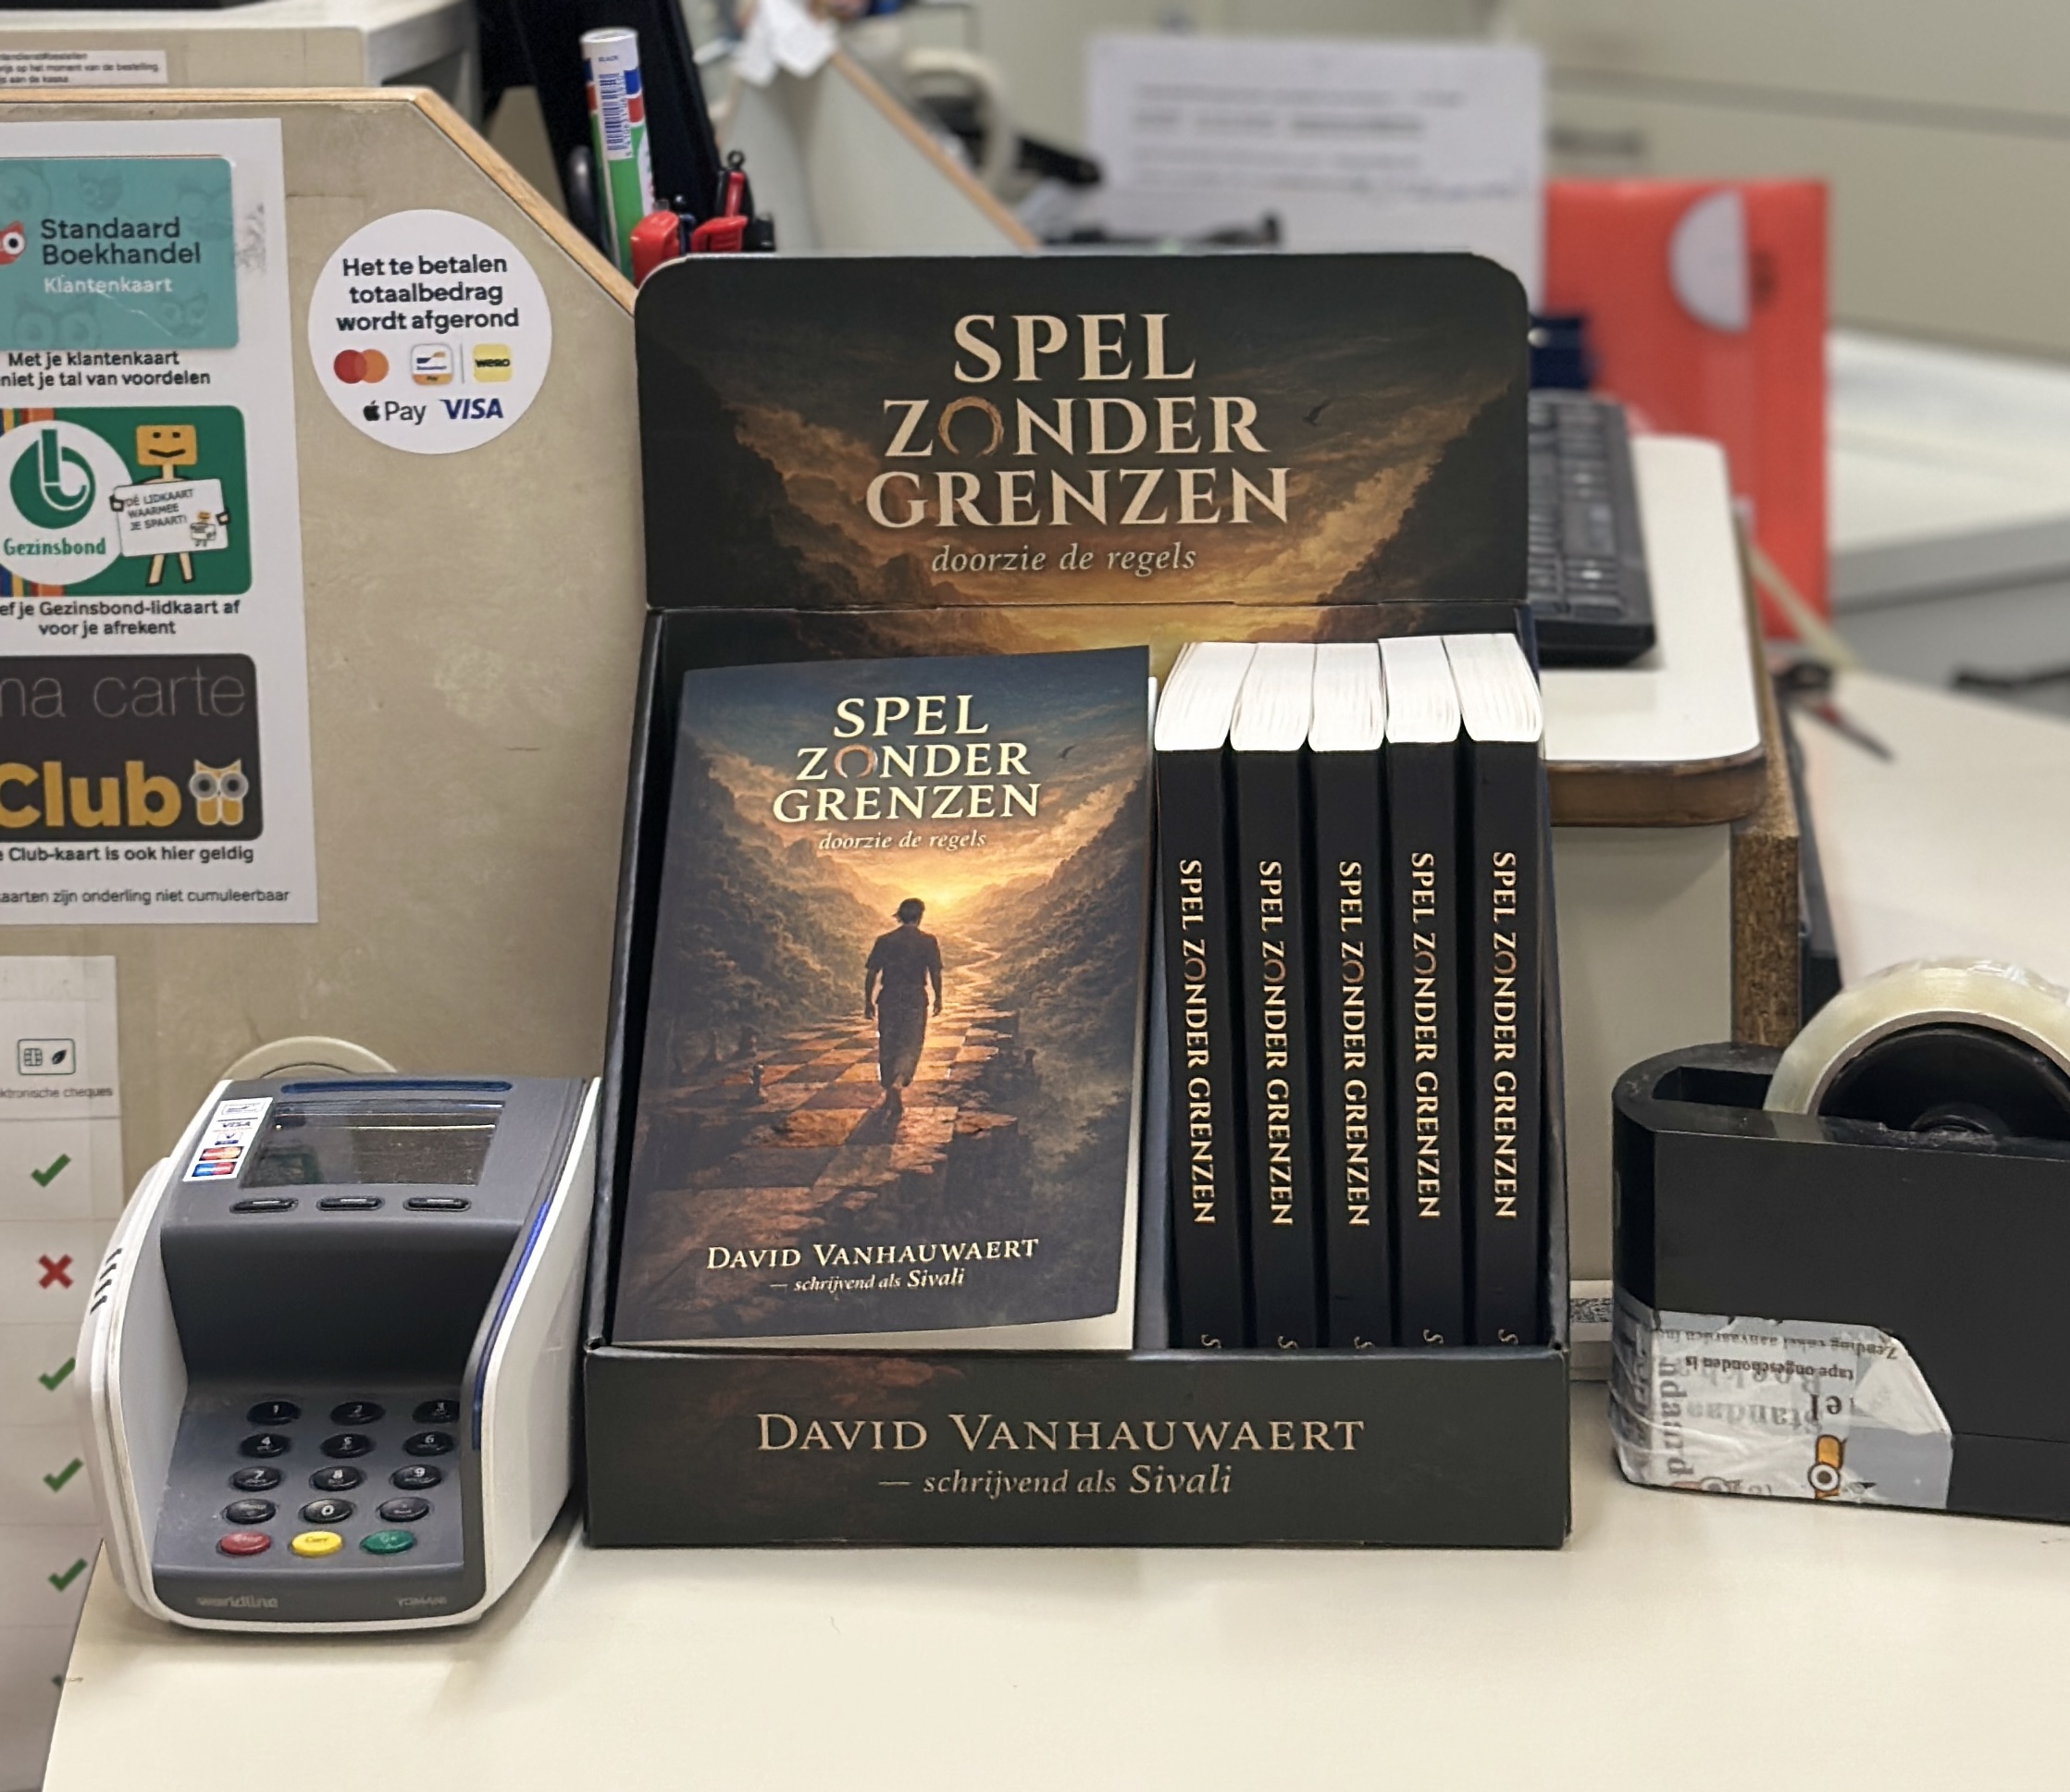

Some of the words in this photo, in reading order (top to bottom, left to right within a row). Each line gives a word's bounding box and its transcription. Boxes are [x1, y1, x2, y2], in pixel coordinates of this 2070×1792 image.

[41, 216, 180, 239] Standaard
[43, 242, 200, 265] Boekhandel
[342, 258, 385, 277] Het
[389, 260, 413, 275] te
[418, 254, 507, 274] betalen
[43, 277, 173, 293] Klantenkaart
[350, 281, 502, 305] totaalbedrag
[336, 311, 407, 331] wordt
[412, 308, 519, 334] afgerond
[8, 352, 42, 366] Met
[45, 352, 62, 369] je
[68, 351, 180, 365] klantenkaart
[953, 314, 1196, 383] SPEL
[38, 372, 54, 389] je
[59, 371, 81, 386] tal
[87, 376, 118, 385] van
[122, 370, 211, 386] voordelen
[385, 401, 427, 426] Pay
[440, 398, 503, 419] VISA
[883, 395, 1271, 458] ZONDER
[143, 488, 193, 505] LIDKAART
[866, 467, 1292, 528] GRENZEN
[128, 503, 180, 519] WAARMEE
[130, 520, 142, 531] JE
[144, 515, 187, 529] SPAART!
[4, 538, 106, 556] Gezinsbond
[932, 544, 1046, 573] doorzie
[1059, 543, 1094, 571] de
[1107, 541, 1196, 577] regels
[18, 601, 34, 619] je
[40, 600, 217, 615] Gezinsbond-lidkaart
[223, 599, 241, 614] af
[38, 623, 78, 635] voor
[83, 621, 99, 638] je
[104, 620, 176, 635] afrekent
[93, 665, 245, 718] carte
[833, 694, 989, 738] SPEL
[796, 742, 1031, 781] ZONDER
[0, 760, 182, 829] Club
[773, 784, 1041, 822] GRENZEN
[819, 832, 892, 850] doorzie
[899, 831, 922, 848] de
[928, 829, 986, 851] regels
[9, 847, 100, 861] Club-kaart
[105, 847, 119, 860] is
[124, 847, 156, 860] ook
[162, 846, 194, 860] hier
[199, 846, 254, 864] geldig
[53, 890, 78, 906] zijn
[81, 890, 151, 905] onderling
[155, 890, 183, 902] niet
[188, 888, 290, 903] cumuleerbaar
[1179, 859, 1204, 932] SPEL
[1258, 860, 1283, 933] SPEL
[1339, 860, 1363, 933] SPEL
[1411, 852, 1435, 924] SPEL
[1493, 851, 1517, 923] SPEL
[1182, 938, 1210, 1069] ZONDER
[1261, 940, 1288, 1071] ZONDER
[1341, 941, 1367, 1071] ZONDER
[1413, 932, 1438, 1064] ZONDER
[1493, 932, 1518, 1063] ZONDER
[63, 1087, 113, 1099] cheques
[1187, 1077, 1216, 1225] GRENZEN
[1266, 1078, 1294, 1227] GRENZEN
[1344, 1079, 1370, 1227] GRENZEN
[1415, 1070, 1440, 1219] GRENZEN
[1493, 1070, 1518, 1219] GRENZEN
[706, 1245, 801, 1269] DAVID
[812, 1238, 1039, 1267] VANHAUWAERT
[793, 1272, 874, 1293] schrijvend
[878, 1273, 901, 1289] als
[907, 1267, 964, 1288] Sivali
[1685, 1356, 1697, 1370] is
[1703, 1357, 1815, 1377] ongeschonden
[1819, 1364, 1854, 1380] tape
[261, 1436, 271, 1445] 4
[425, 1434, 435, 1443] 6
[757, 1414, 927, 1452] DAVID
[948, 1414, 1365, 1452] VANHAUWAERT
[254, 1469, 265, 1479] 7
[415, 1467, 426, 1477] 9
[923, 1470, 1067, 1501] schrijvend
[1076, 1470, 1117, 1494] als
[1129, 1464, 1233, 1495] Sivali
[322, 1504, 334, 1515] 0
[196, 1596, 279, 1610] worldline
